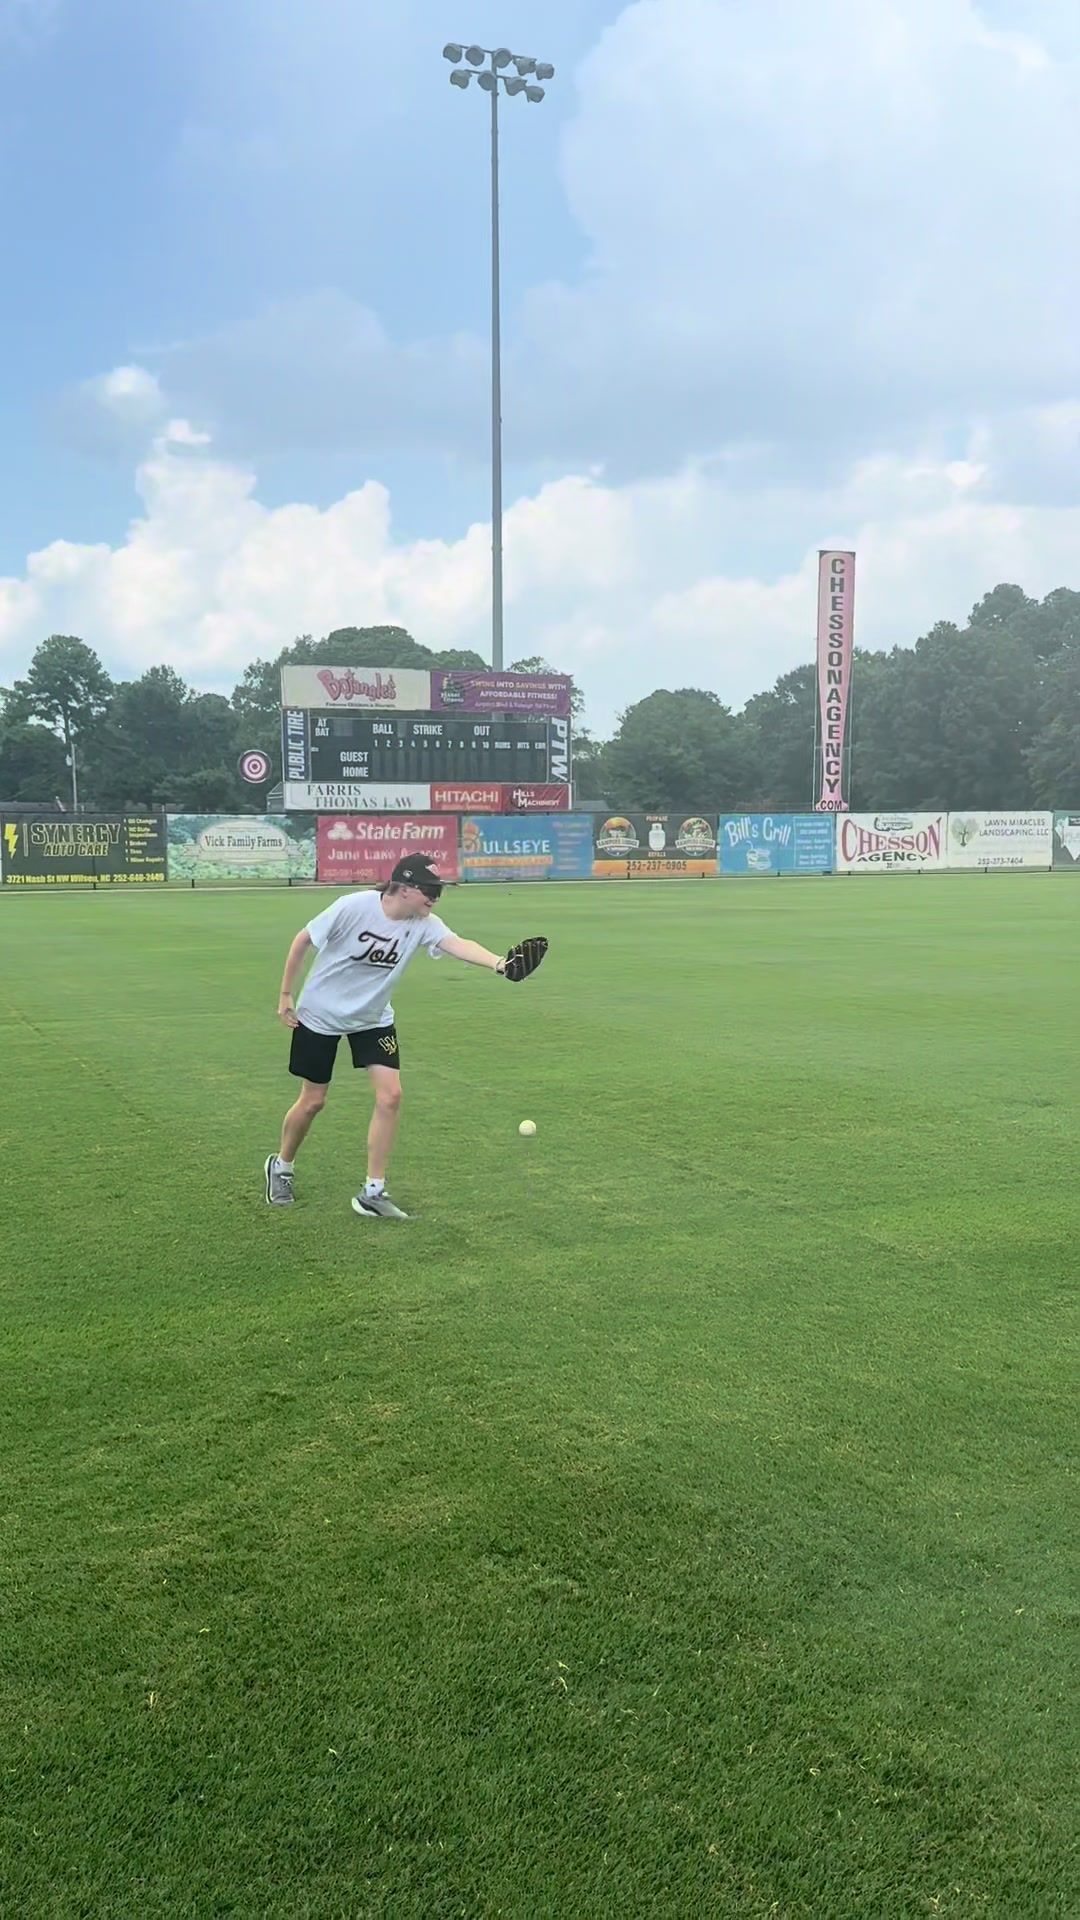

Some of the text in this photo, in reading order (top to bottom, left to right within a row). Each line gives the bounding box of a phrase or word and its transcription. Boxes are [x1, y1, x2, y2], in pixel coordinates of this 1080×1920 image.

[480, 690, 525, 698] AFFORDABLE
[317, 719, 327, 727] AT
[315, 727, 330, 736] BAT
[372, 724, 490, 736] BALL STRIKE OUT
[286, 710, 305, 780] PUBLIC TIRE
[340, 752, 368, 762] GUEST
[343, 767, 369, 777] HOME
[307, 785, 361, 795] FARRIS
[513, 789, 535, 799] HILLS
[435, 790, 498, 803] HITACHI
[313, 797, 412, 808] THOMAS LAW
[817, 800, 842, 810] .COM
[984, 819, 1046, 827] LAWN MIRACLES
[31, 823, 121, 844] SYNERGY
[725, 816, 791, 847] Bill's Grill
[1037, 828, 1049, 836] LLC
[205, 836, 282, 849] Vick Family Farms
[842, 816, 942, 862] CHESSON
[43, 843, 109, 857] AUTO CARE
[857, 851, 927, 862] AGENCY
[7, 874, 25, 883] 3721
[26, 874, 45, 883] Nash
[46, 874, 55, 883] St
[350, 931, 404, 964] Tob
